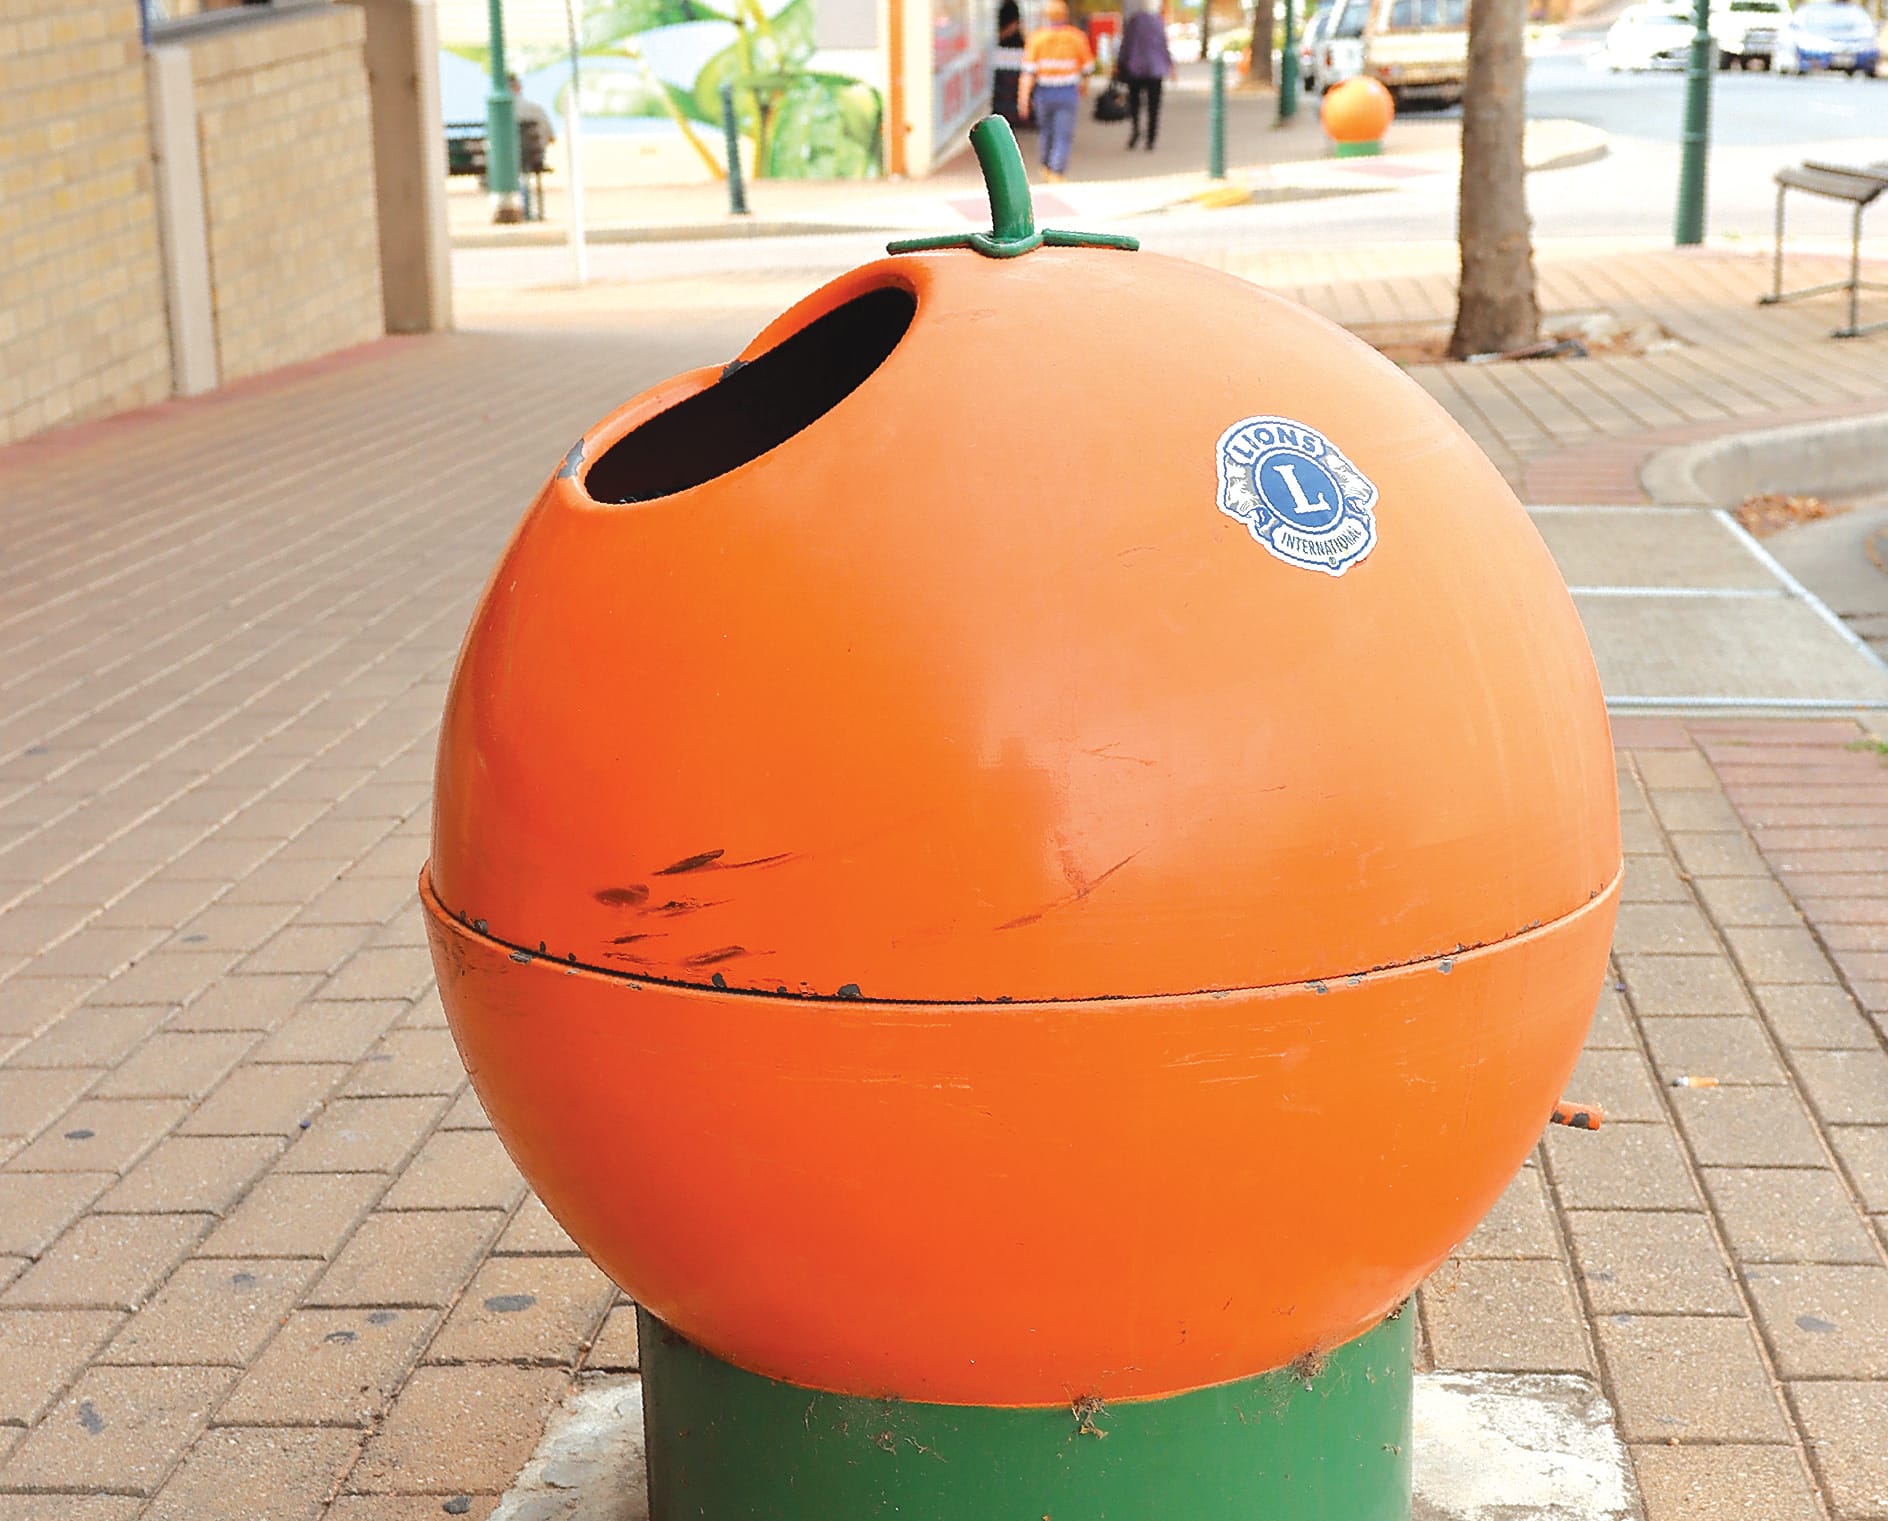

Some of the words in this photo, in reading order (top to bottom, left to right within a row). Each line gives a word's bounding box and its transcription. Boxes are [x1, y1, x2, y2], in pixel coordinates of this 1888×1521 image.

[1232, 427, 1316, 459] LIONS
[1272, 464, 1332, 514] L
[1281, 525, 1362, 556] INTERNATIONAL
